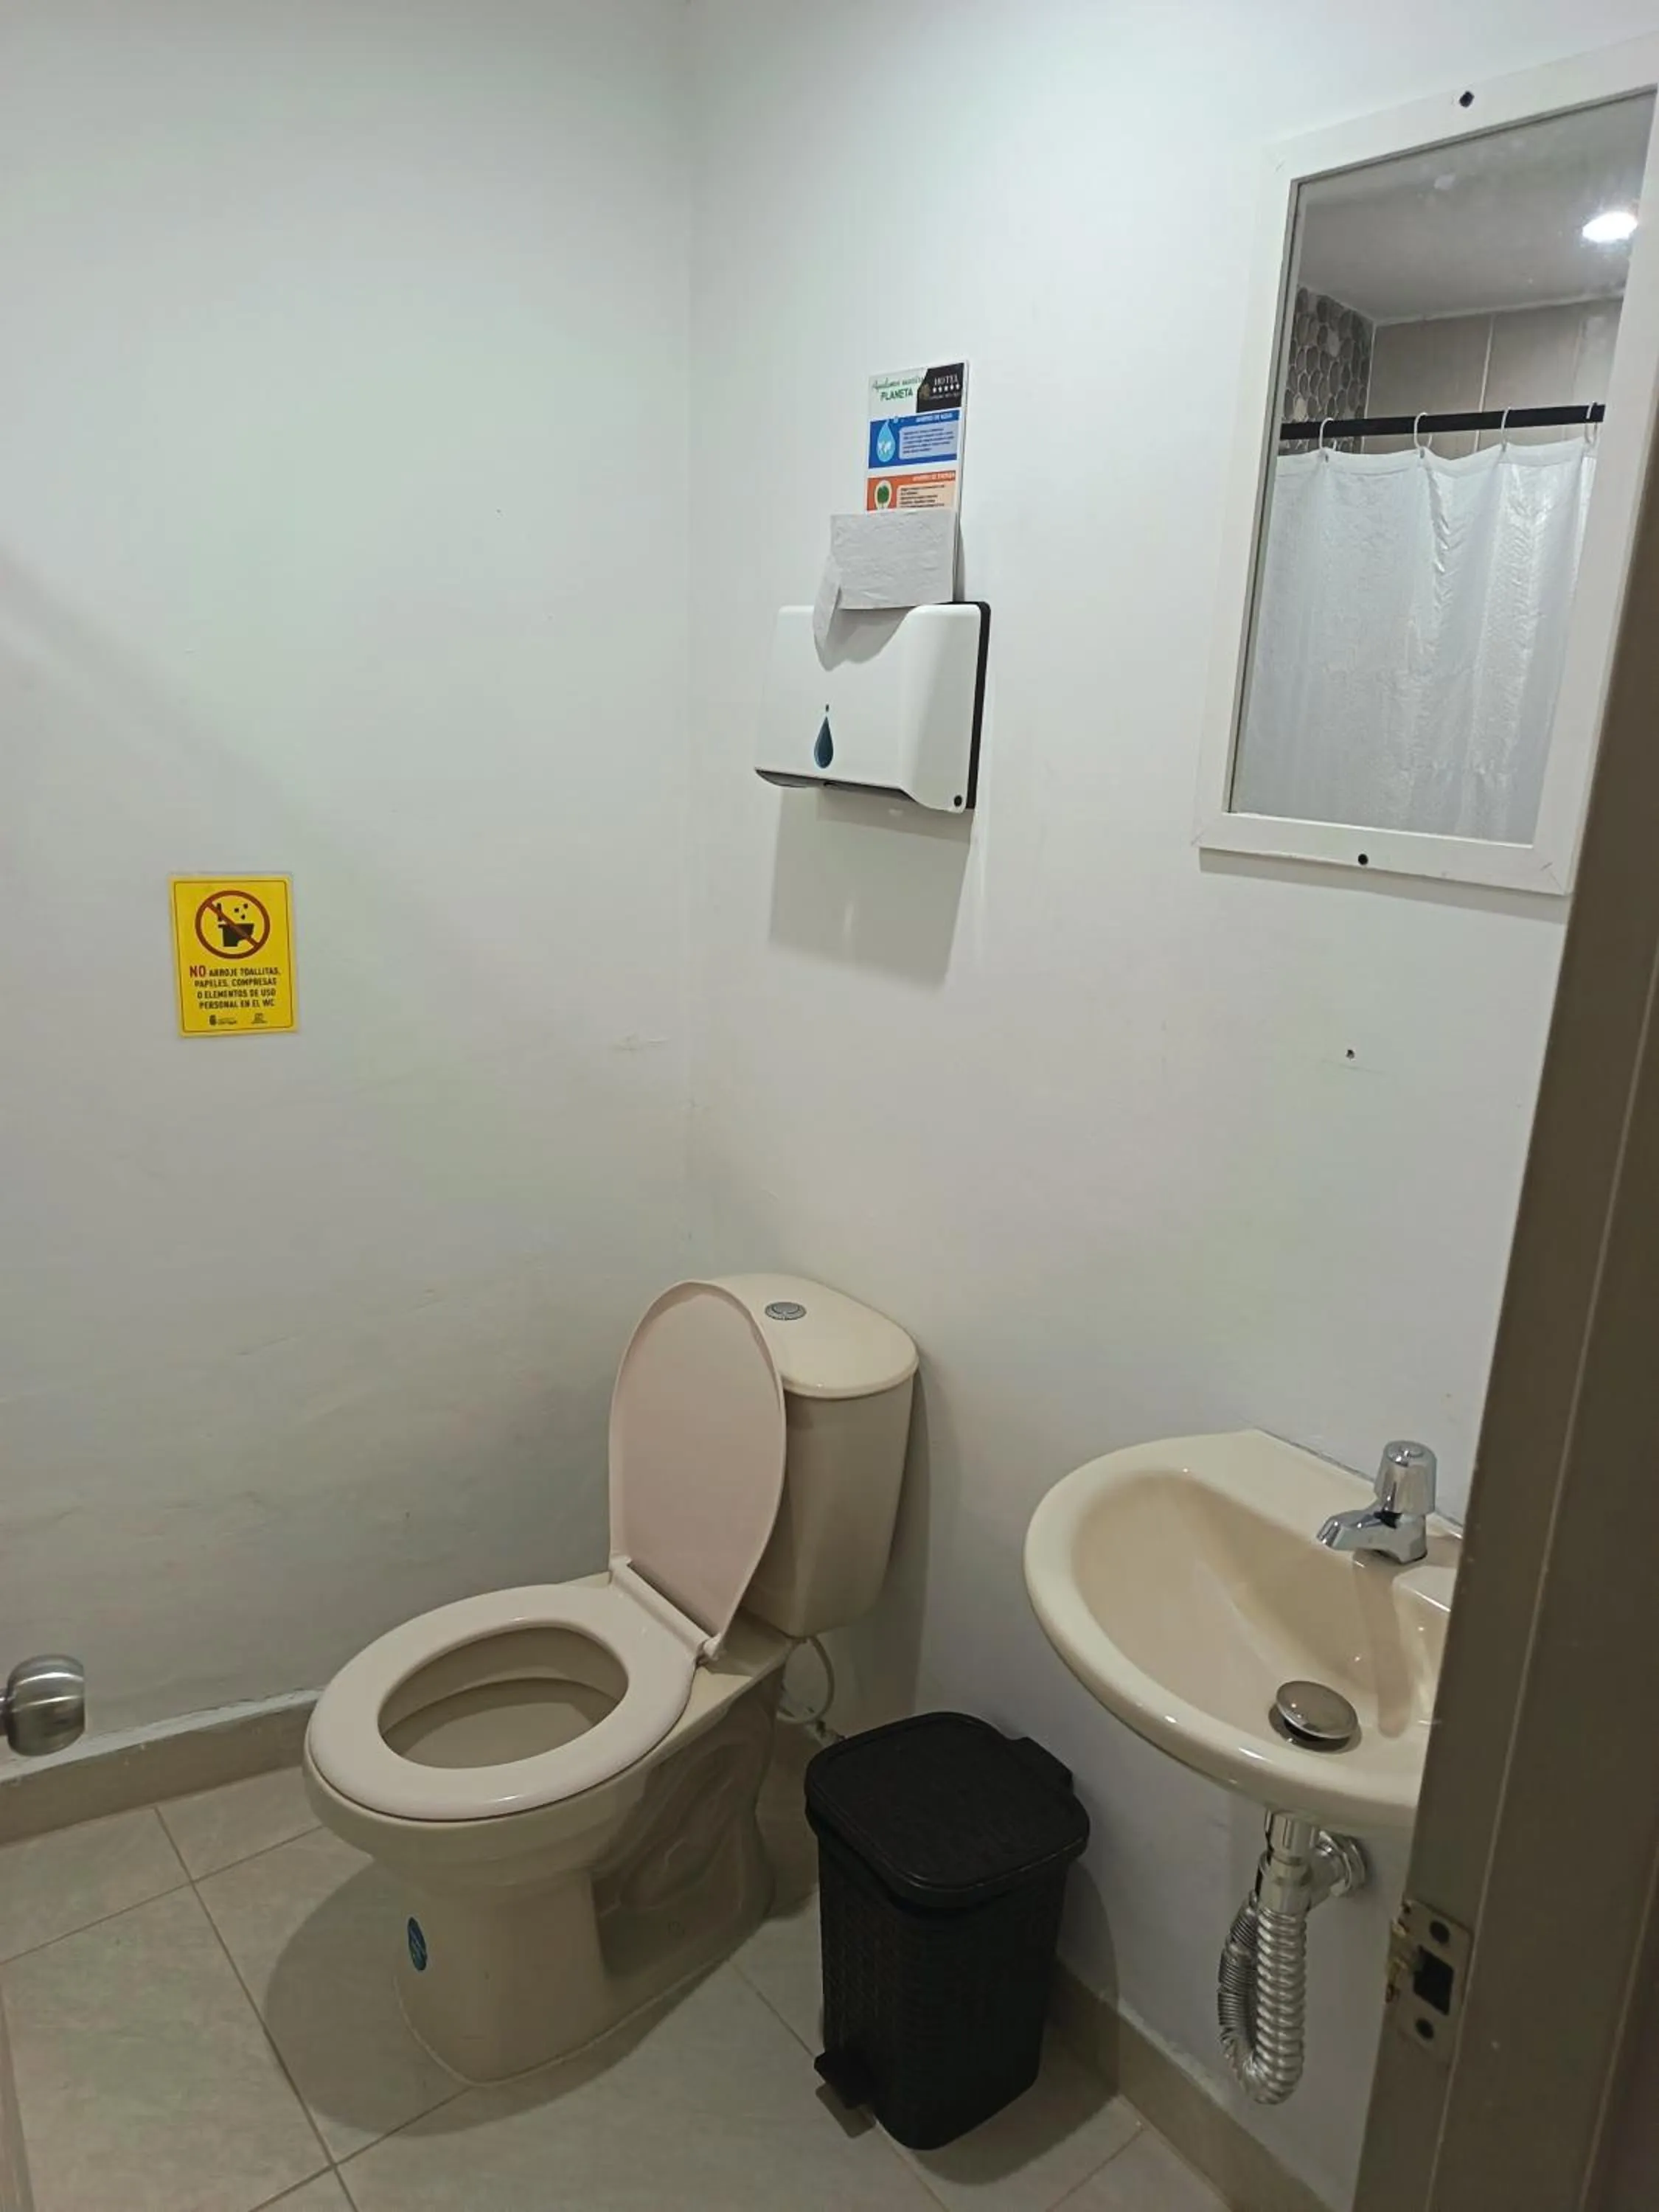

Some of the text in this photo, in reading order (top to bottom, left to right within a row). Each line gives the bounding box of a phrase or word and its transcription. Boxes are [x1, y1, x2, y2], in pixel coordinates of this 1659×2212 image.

[880, 388, 914, 401] PLANETA
[189, 965, 206, 978] NO
[209, 968, 237, 976] ARROJE
[232, 978, 276, 987] COMPRESAS
[197, 988, 276, 999] O ELEMENTOS DE USO
[199, 1000, 237, 1009] PERSONAL
[240, 999, 250, 1008] EN
[262, 998, 275, 1007] WC
